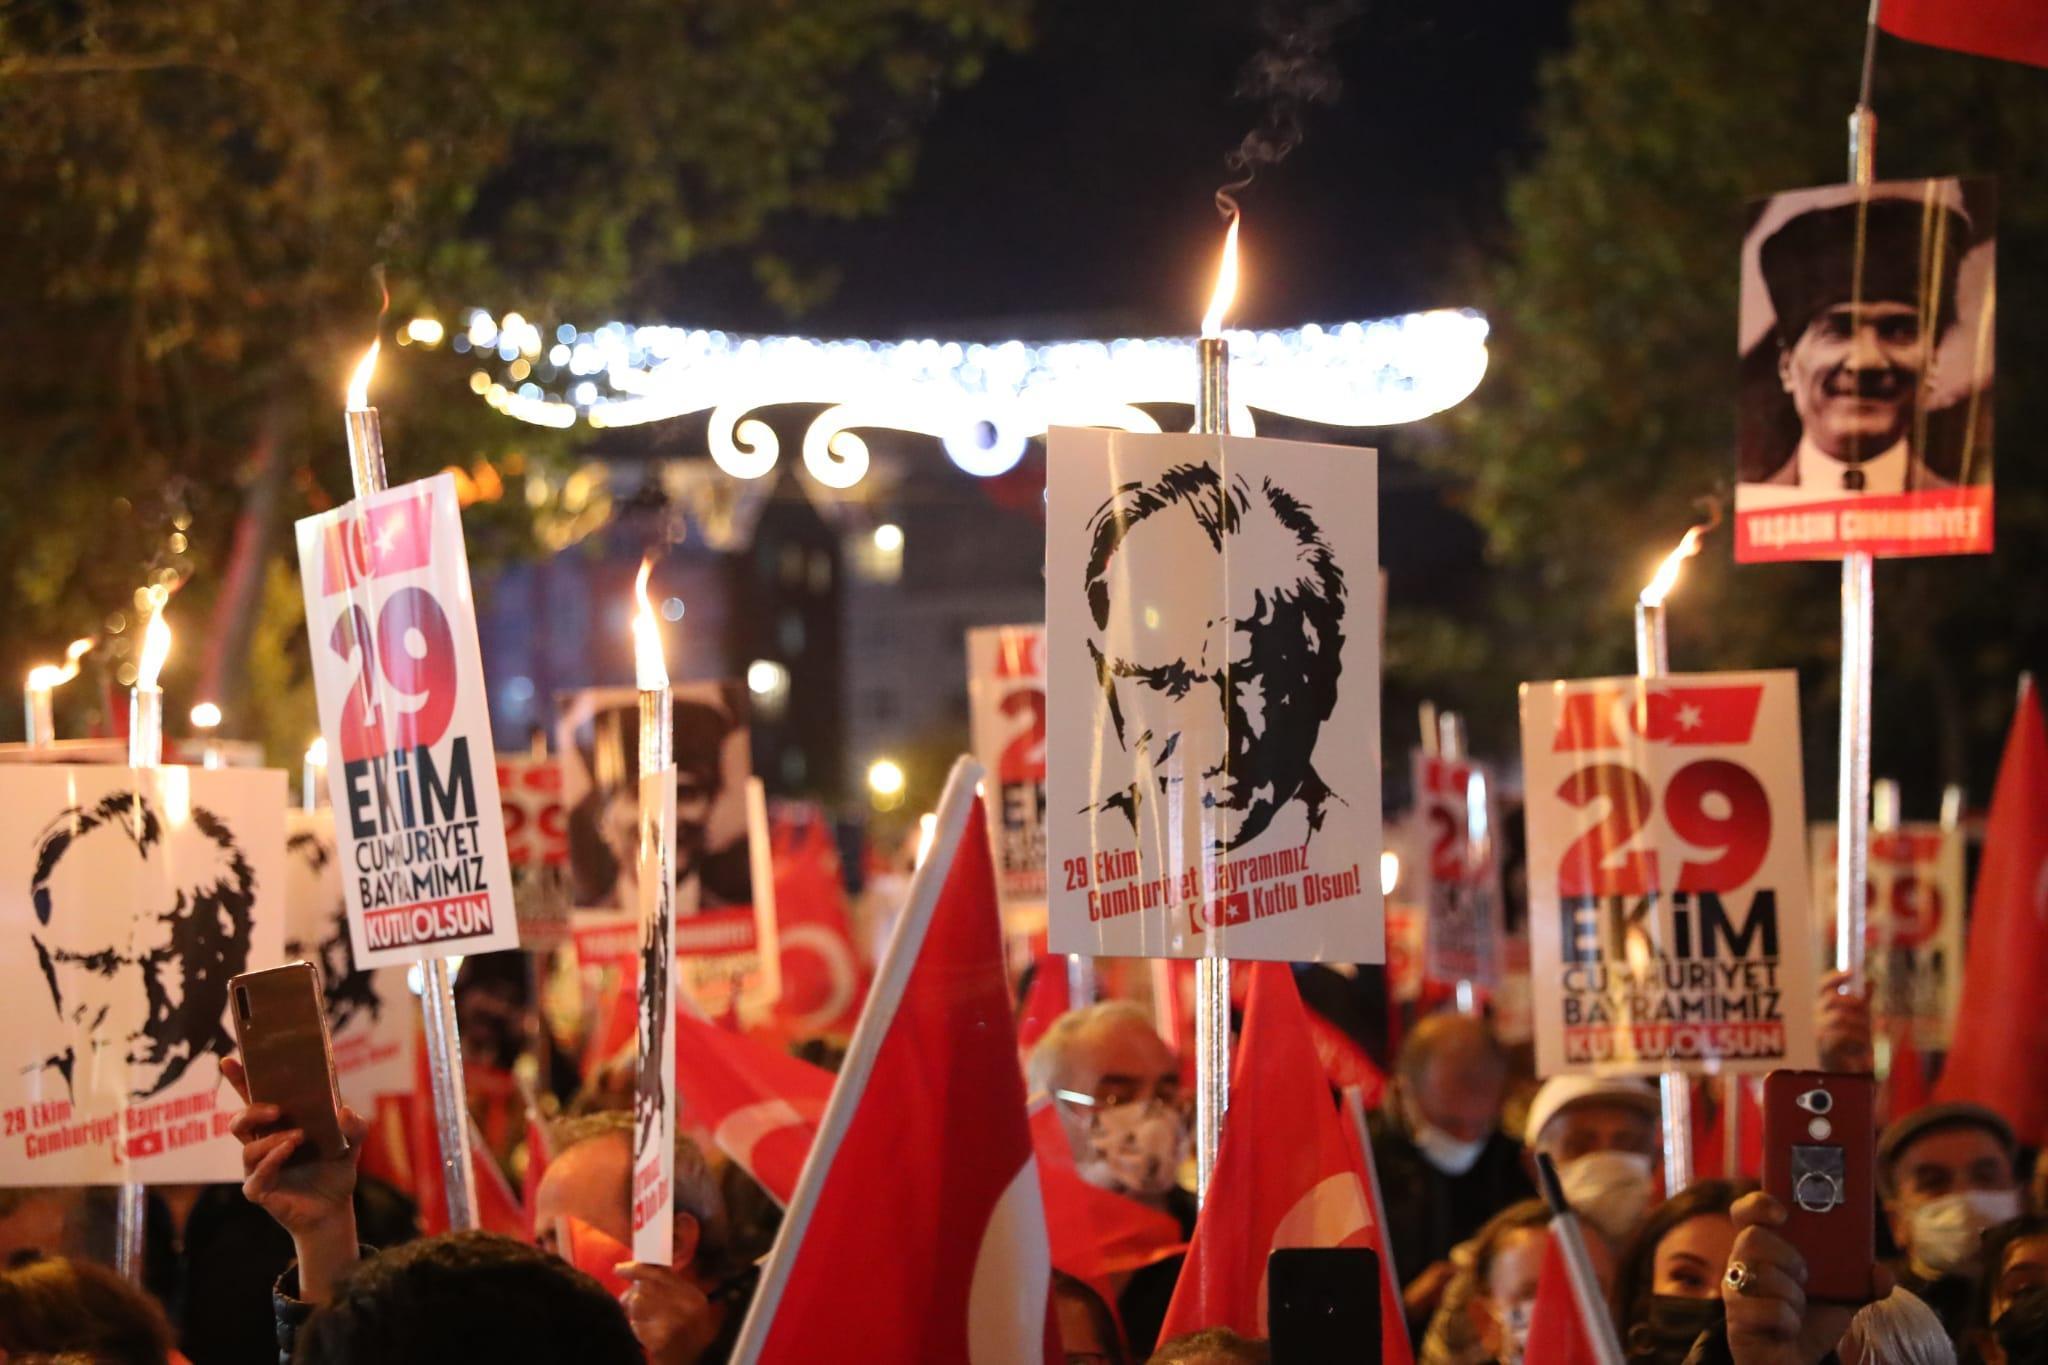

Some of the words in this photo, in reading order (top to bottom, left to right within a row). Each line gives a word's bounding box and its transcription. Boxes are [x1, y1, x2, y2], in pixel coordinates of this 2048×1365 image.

[329, 586, 458, 763] 29
[998, 688, 1046, 783] 2
[345, 736, 477, 840] EKİM
[356, 821, 480, 873] CUMURİYET
[1557, 758, 1771, 898] 29
[359, 857, 487, 909] BAYAMIMIZ
[1064, 856, 1088, 891] 29
[1096, 849, 1141, 884] Ekim
[1253, 884, 1298, 919] Kutlu
[1303, 864, 1361, 907] Olsun!
[412, 899, 490, 940] OLSUN
[1560, 889, 1778, 962] EKİM
[1568, 1028, 1665, 1061] KULU
[3, 1106, 26, 1137] 29
